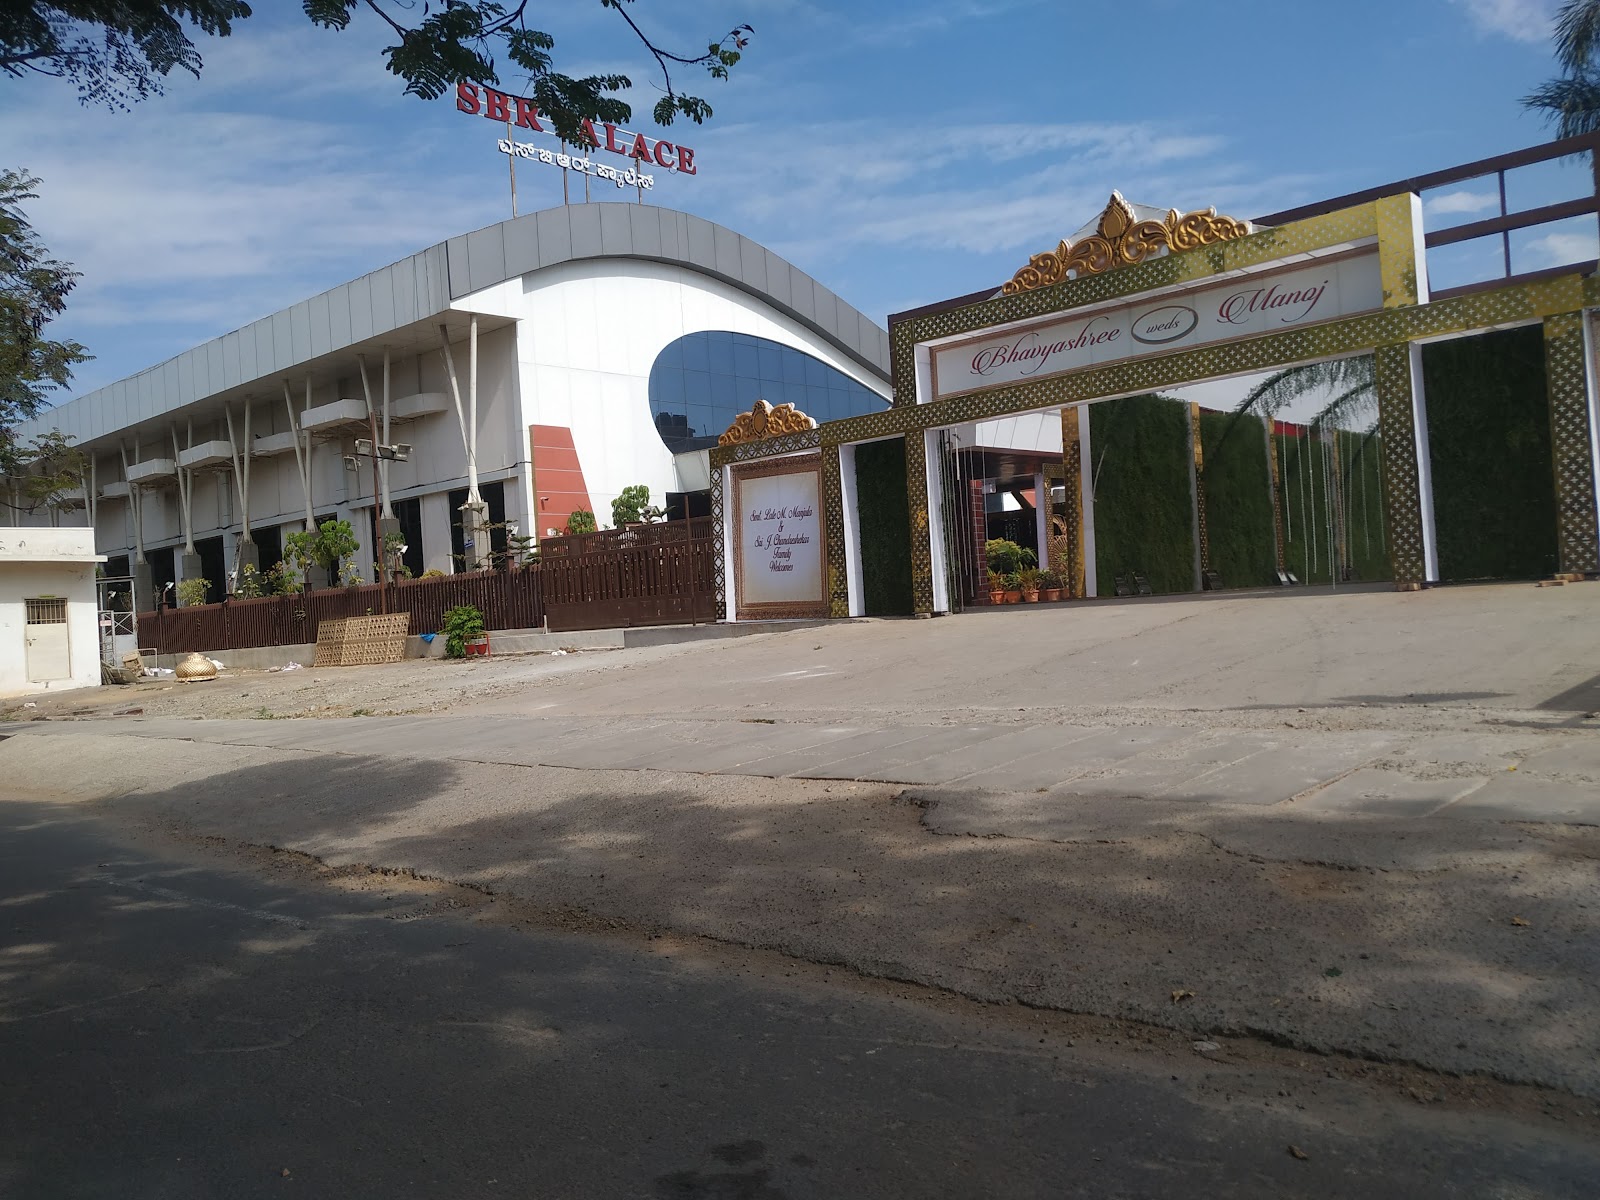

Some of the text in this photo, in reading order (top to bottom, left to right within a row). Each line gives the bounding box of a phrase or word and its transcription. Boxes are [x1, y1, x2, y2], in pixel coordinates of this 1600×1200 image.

[457, 82, 697, 175] SBR ALACE
[970, 280, 1330, 376] Bhavyashree weds Manoj
[778, 520, 784, 532] &
[773, 547, 792, 562] Family
[769, 560, 793, 572] Welcomes
